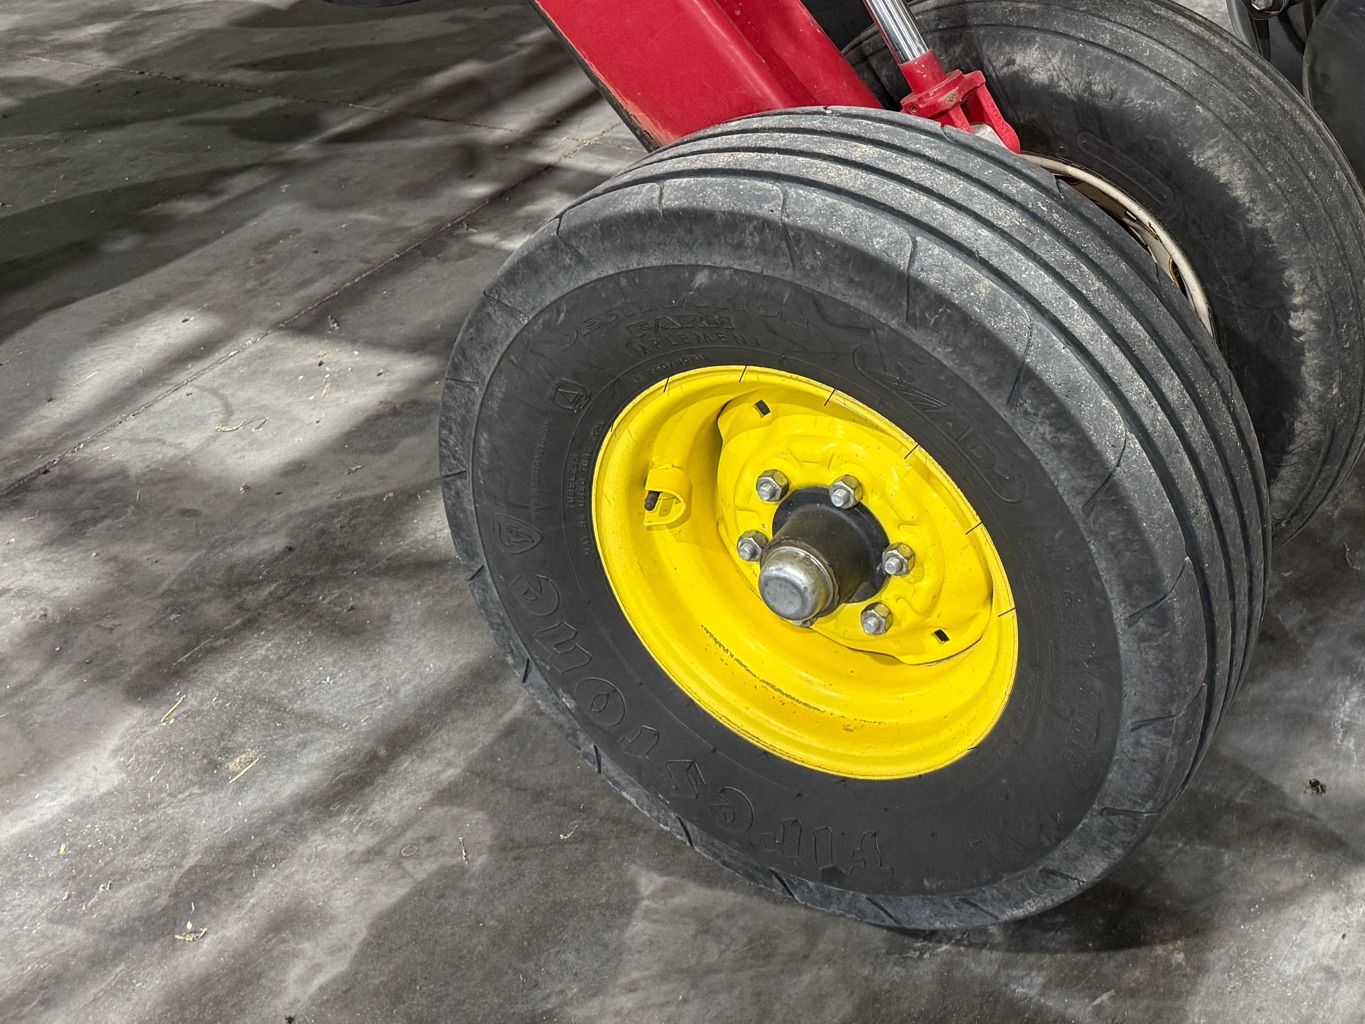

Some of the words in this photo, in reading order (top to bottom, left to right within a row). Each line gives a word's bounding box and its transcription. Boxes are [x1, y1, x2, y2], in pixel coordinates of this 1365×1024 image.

[625, 314, 736, 339] FARM
[624, 330, 762, 359] IMPLEMENT
[579, 447, 593, 473] TUBE
[567, 453, 580, 509] TUBELESS
[577, 478, 588, 508] USED
